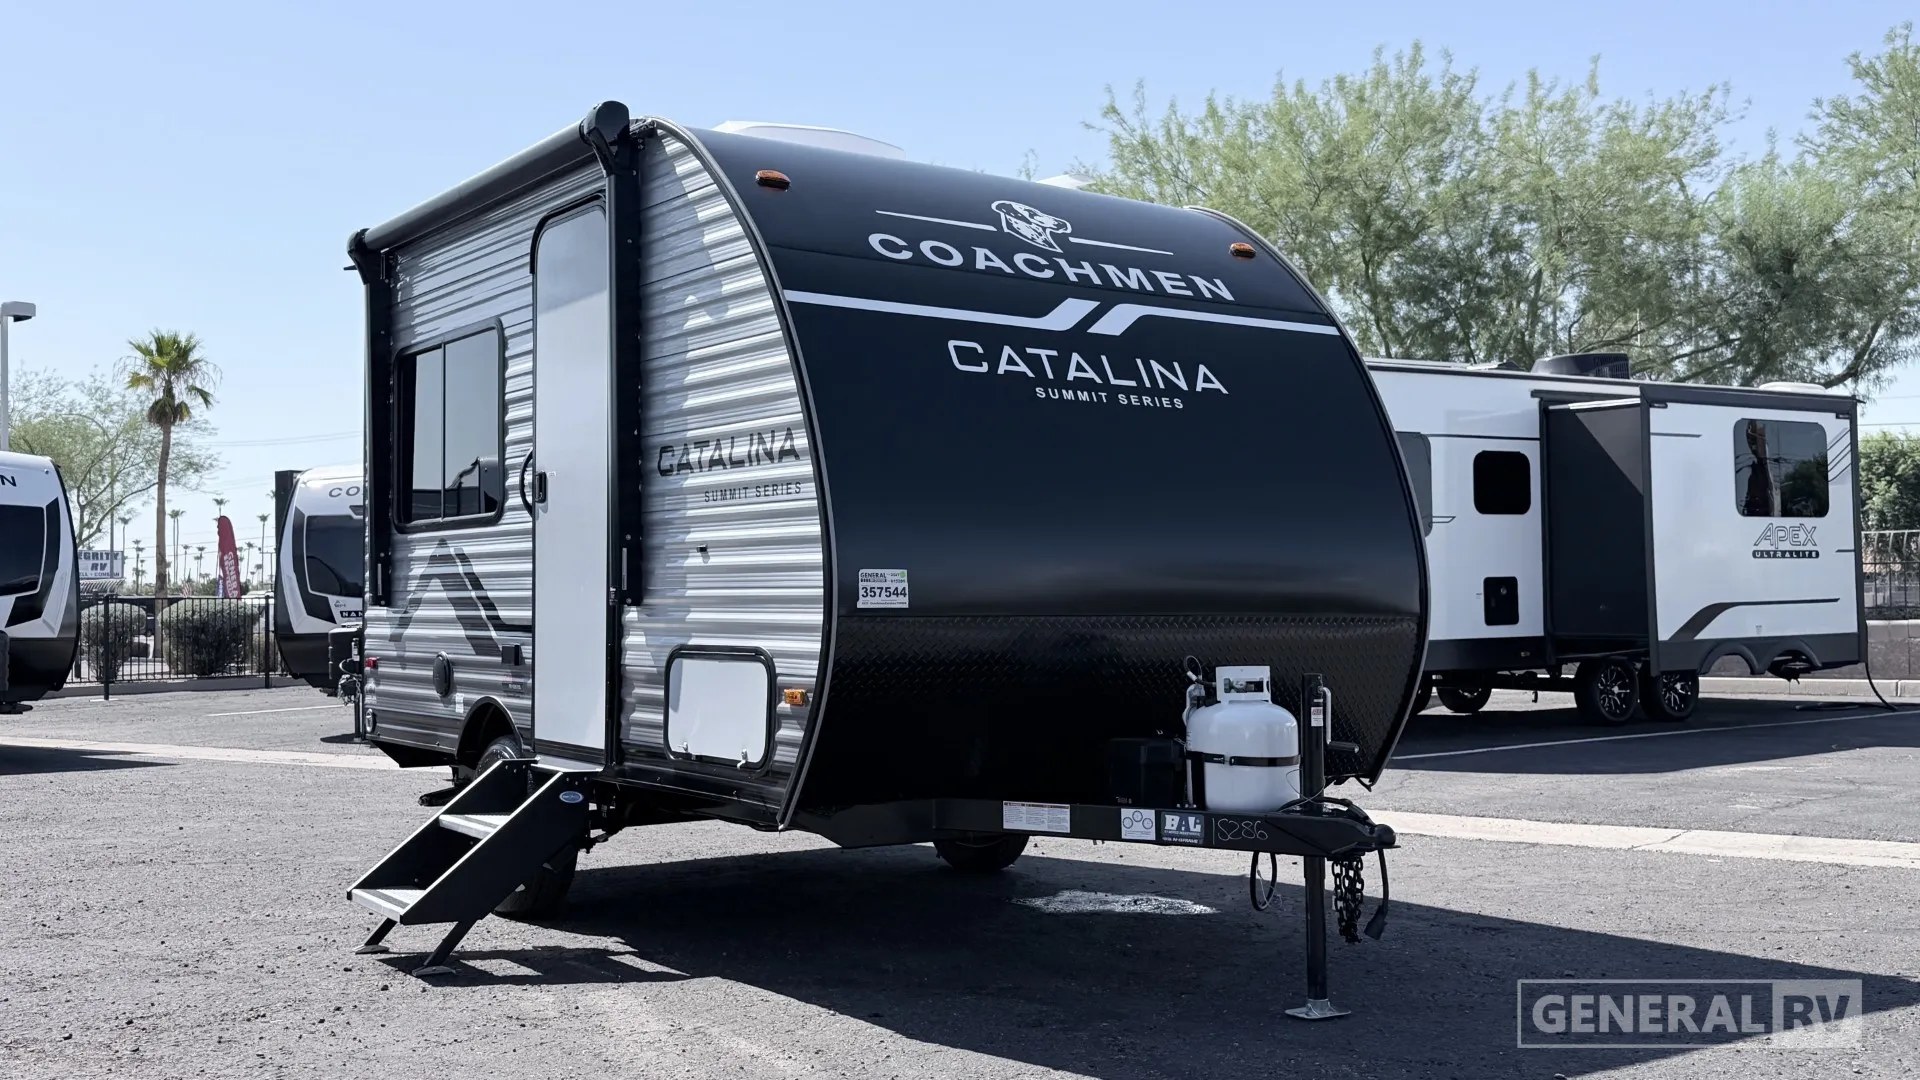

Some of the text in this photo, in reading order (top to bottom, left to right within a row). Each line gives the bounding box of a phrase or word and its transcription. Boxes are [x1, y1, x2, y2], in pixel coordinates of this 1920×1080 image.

[868, 233, 1235, 301] COACHMEN
[947, 339, 1229, 394] CATALINA
[1035, 387, 1184, 409] SUMMIT SERIES
[657, 427, 801, 477] CATALINA
[704, 482, 801, 503] SUMMIT SERIES
[1753, 522, 1818, 549] APEX
[91, 563, 107, 571] RV
[861, 586, 907, 598] 357544
